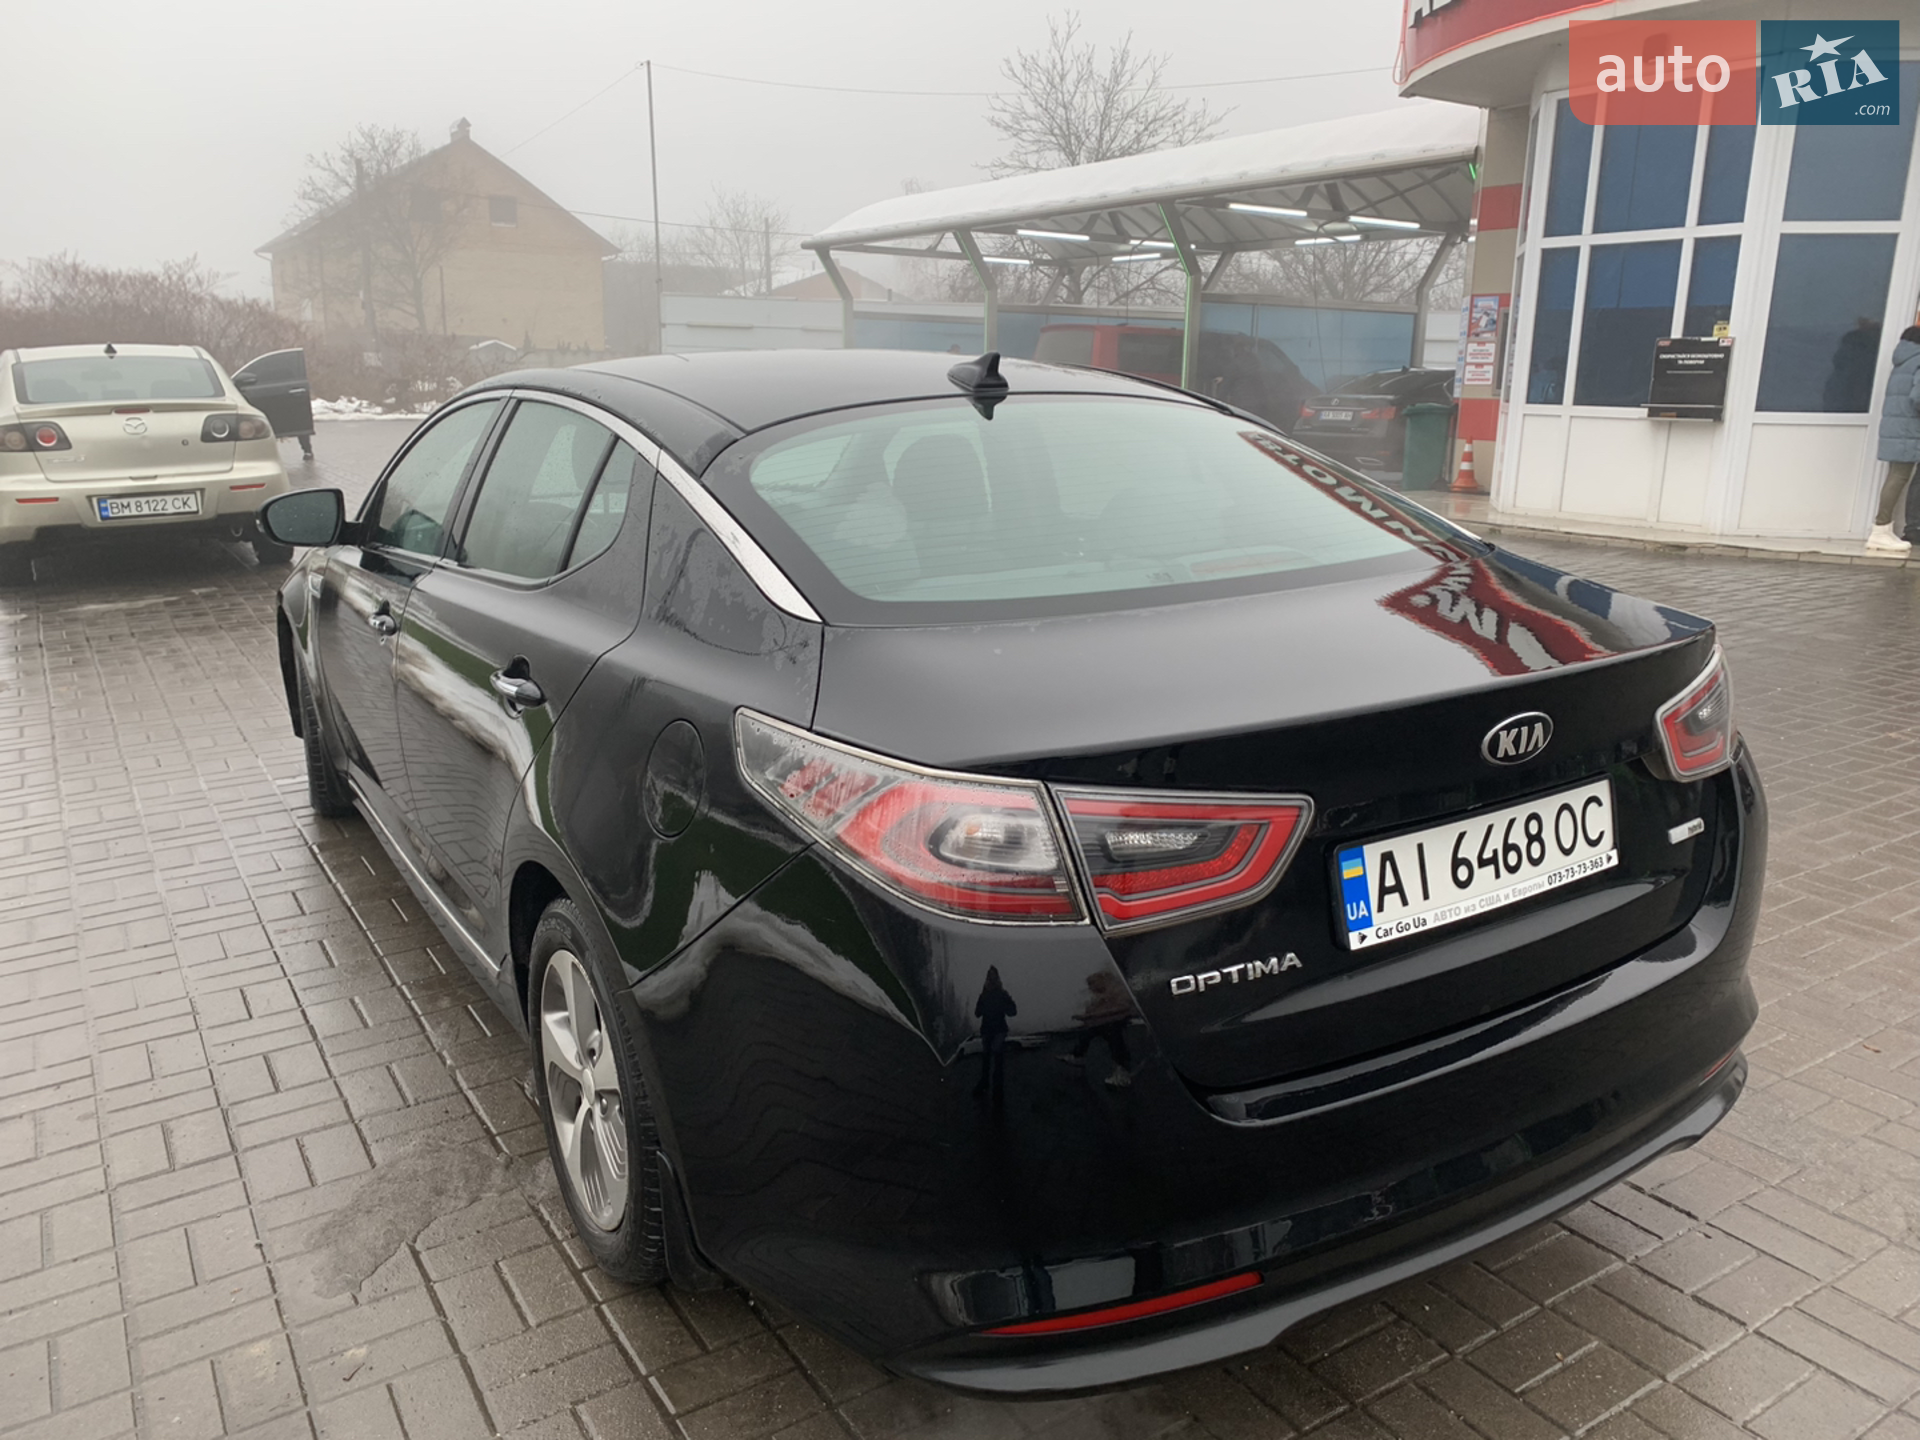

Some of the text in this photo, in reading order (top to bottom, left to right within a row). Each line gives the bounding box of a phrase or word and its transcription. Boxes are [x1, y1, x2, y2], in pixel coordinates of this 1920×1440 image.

[109, 501, 132, 515] BM
[134, 498, 169, 513] 8122
[171, 496, 192, 510] CK
[1496, 722, 1544, 758] KIA
[1376, 795, 1605, 913] AI 6468 OC
[1547, 856, 1604, 886] 073-73-73-363
[1346, 901, 1369, 921] UA
[1432, 881, 1545, 924] АВТО из США и Европы
[1375, 916, 1428, 940] Car Go Ua
[1169, 952, 1303, 996] OPTIMA
